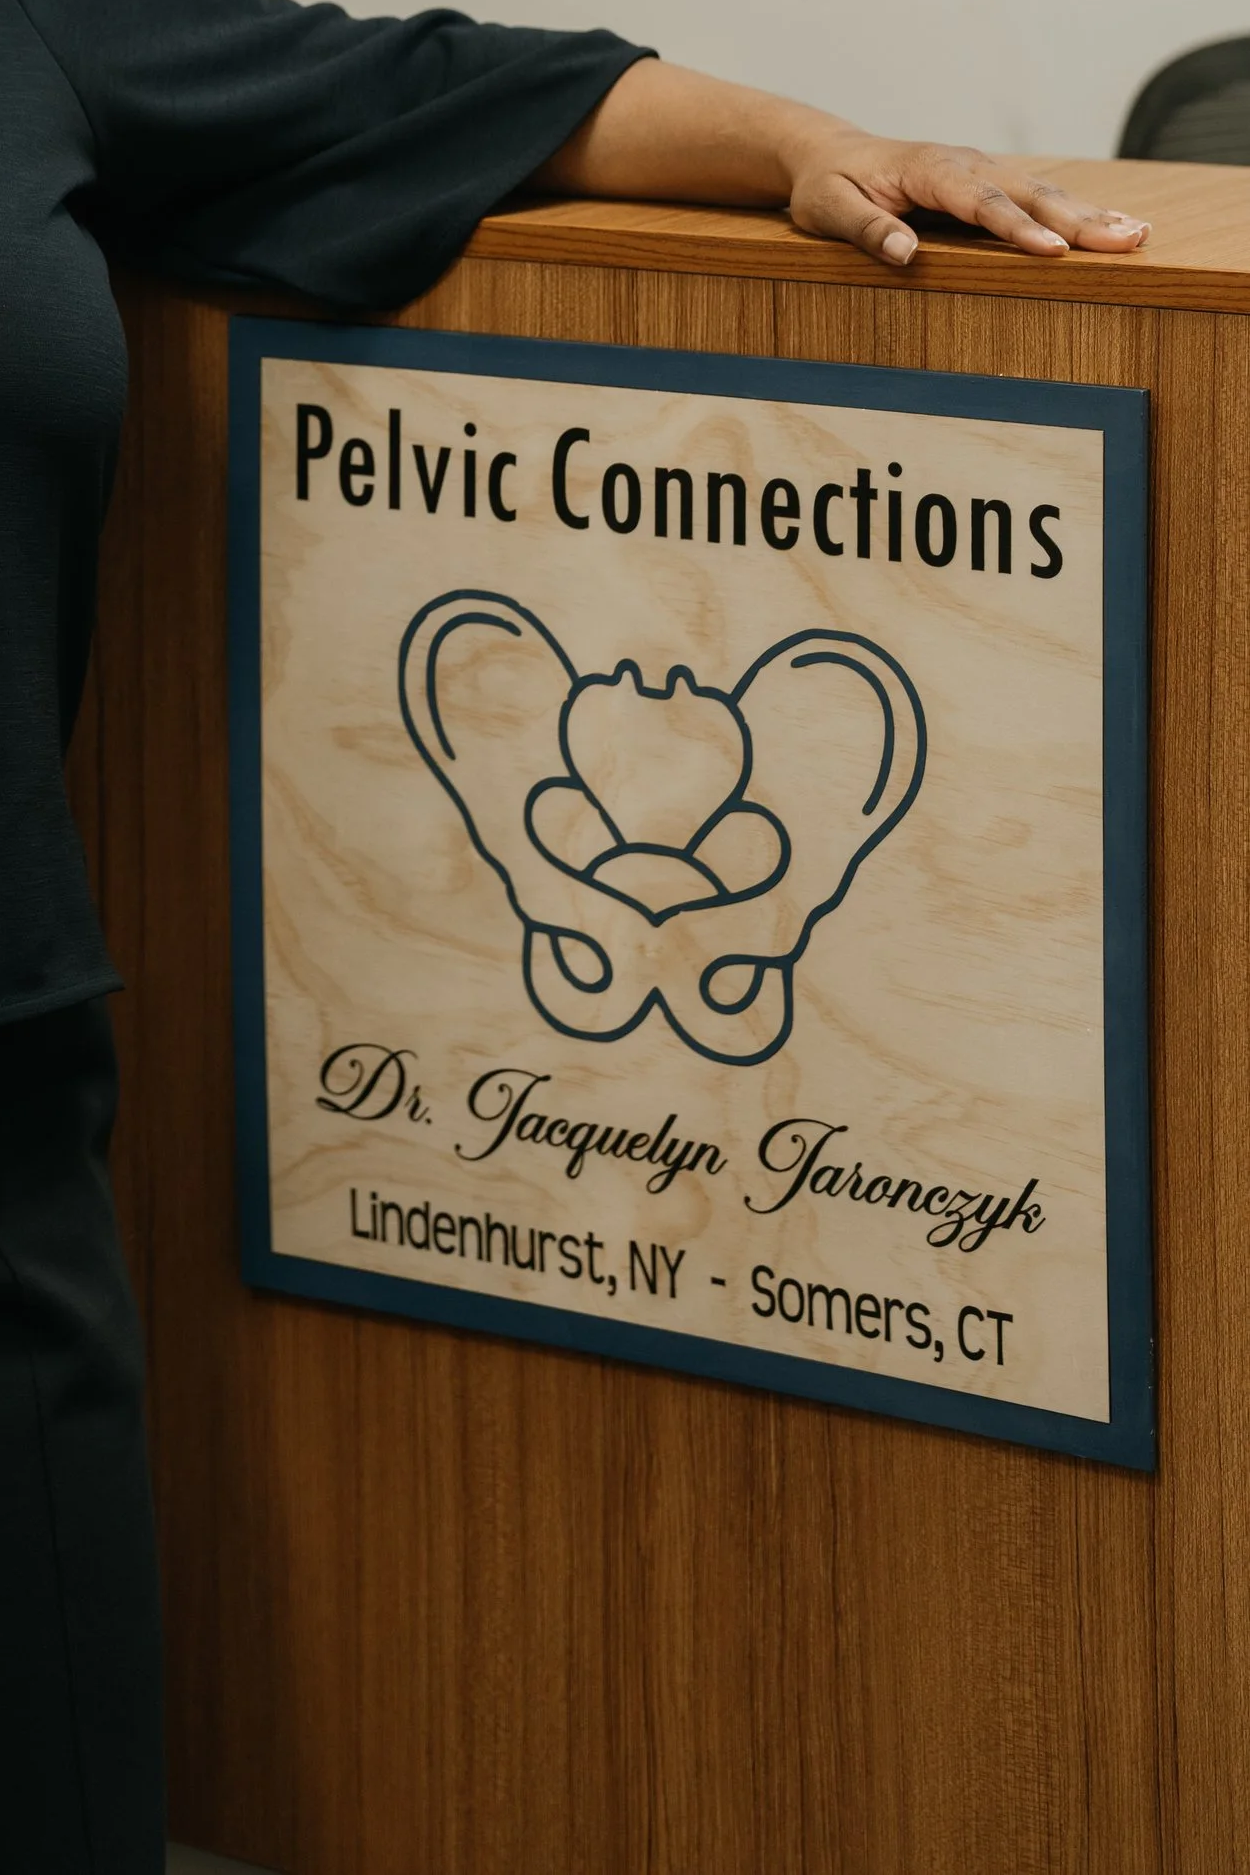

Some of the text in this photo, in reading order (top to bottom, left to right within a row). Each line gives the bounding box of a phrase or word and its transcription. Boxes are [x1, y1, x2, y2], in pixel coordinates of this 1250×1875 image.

[294, 401, 1065, 581] Pelvic Connections
[314, 1042, 1047, 1254] Dr. Jacquelyn Jaronczyk
[348, 1186, 618, 1298] Lindenhurst,
[628, 1239, 687, 1300] NY
[750, 1263, 945, 1364] Somers,
[956, 1304, 1015, 1367] CT
